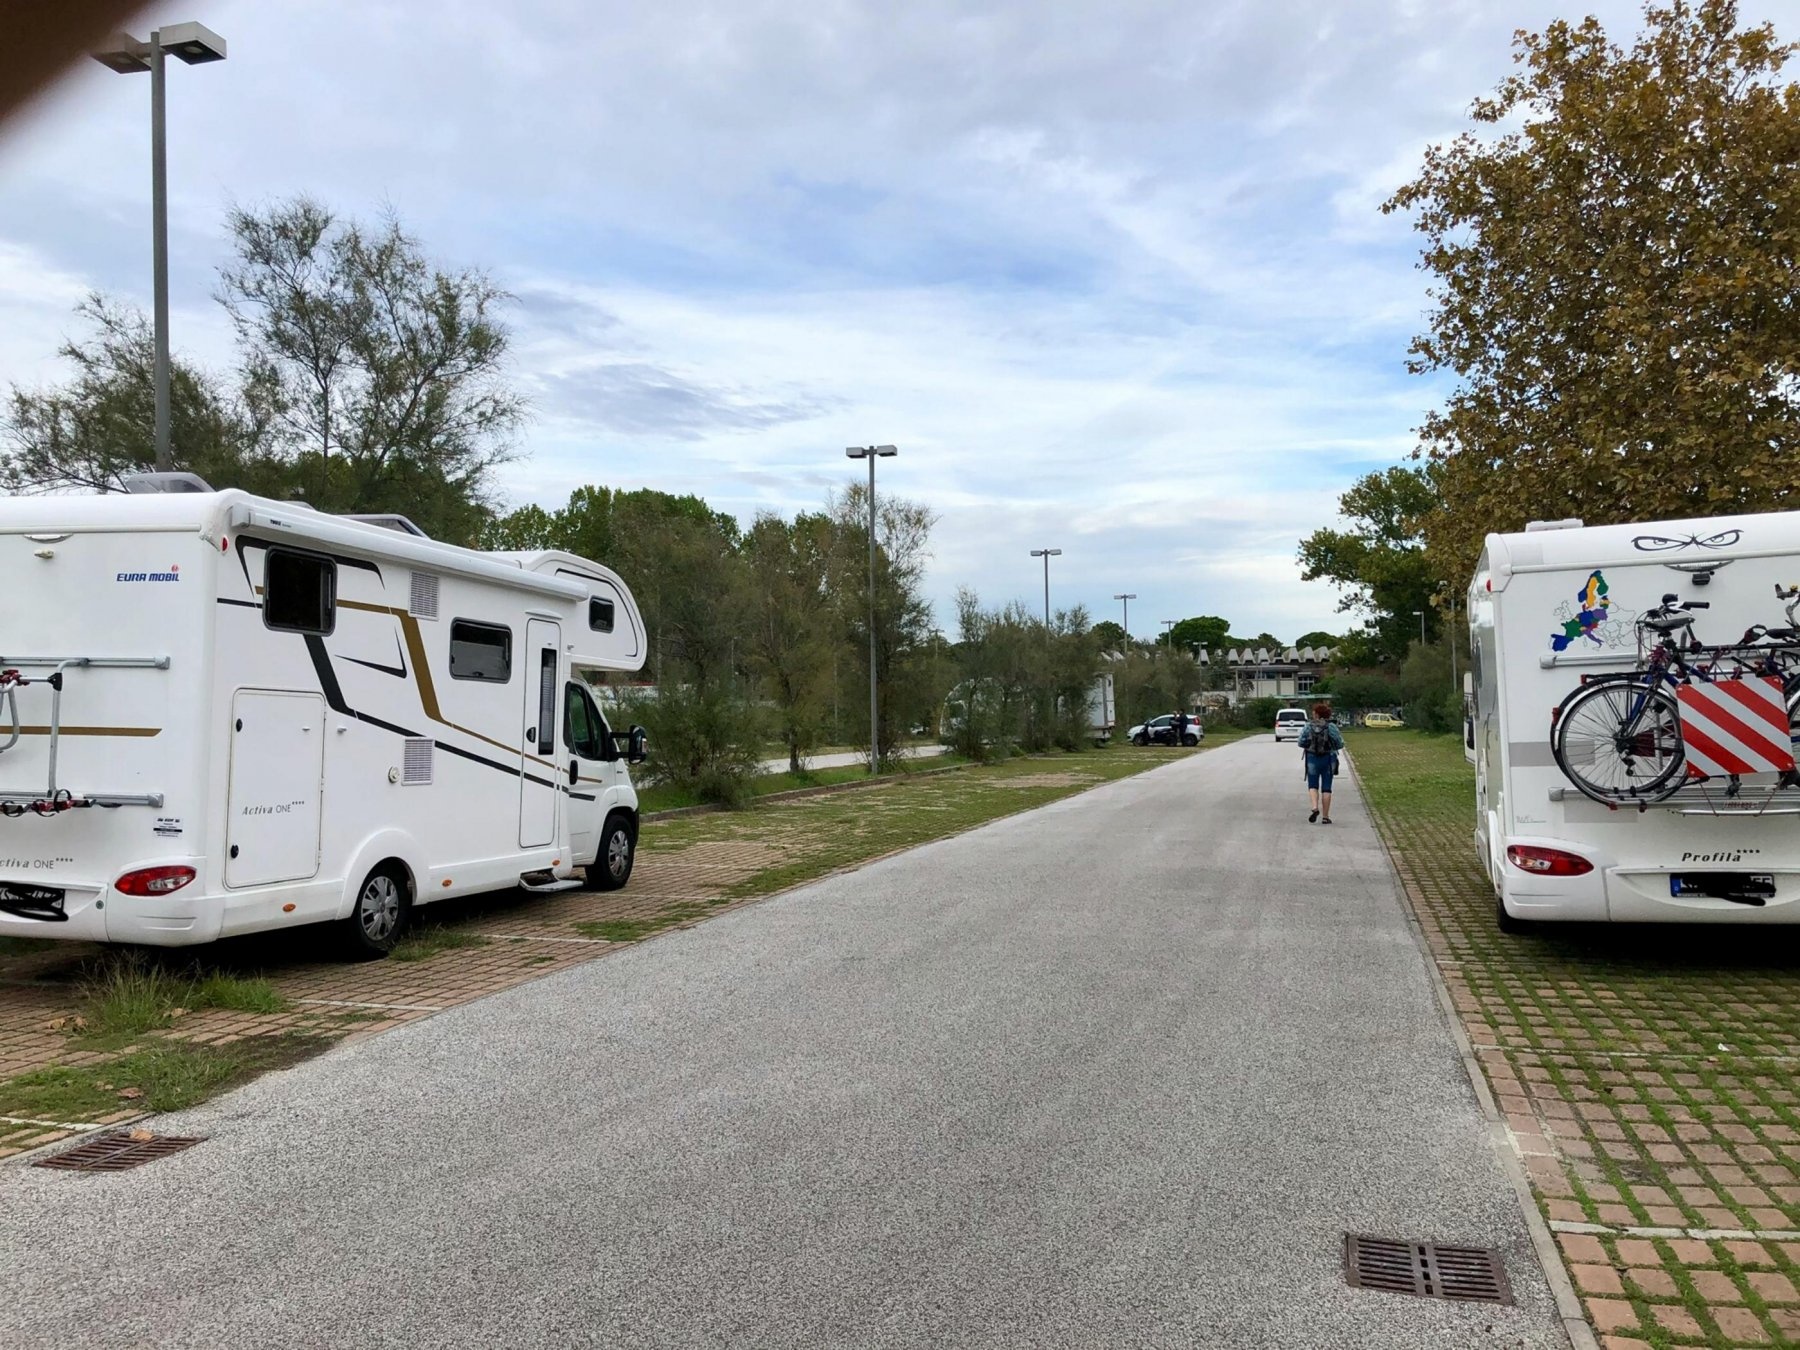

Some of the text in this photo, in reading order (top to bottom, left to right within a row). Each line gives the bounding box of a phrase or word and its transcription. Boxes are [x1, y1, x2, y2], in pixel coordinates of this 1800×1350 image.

[116, 573, 180, 582] EURA MOBIL
[242, 804, 291, 816] Activa ONE
[1681, 852, 1741, 862] Profila
[0, 858, 55, 870] ctiva ONE
